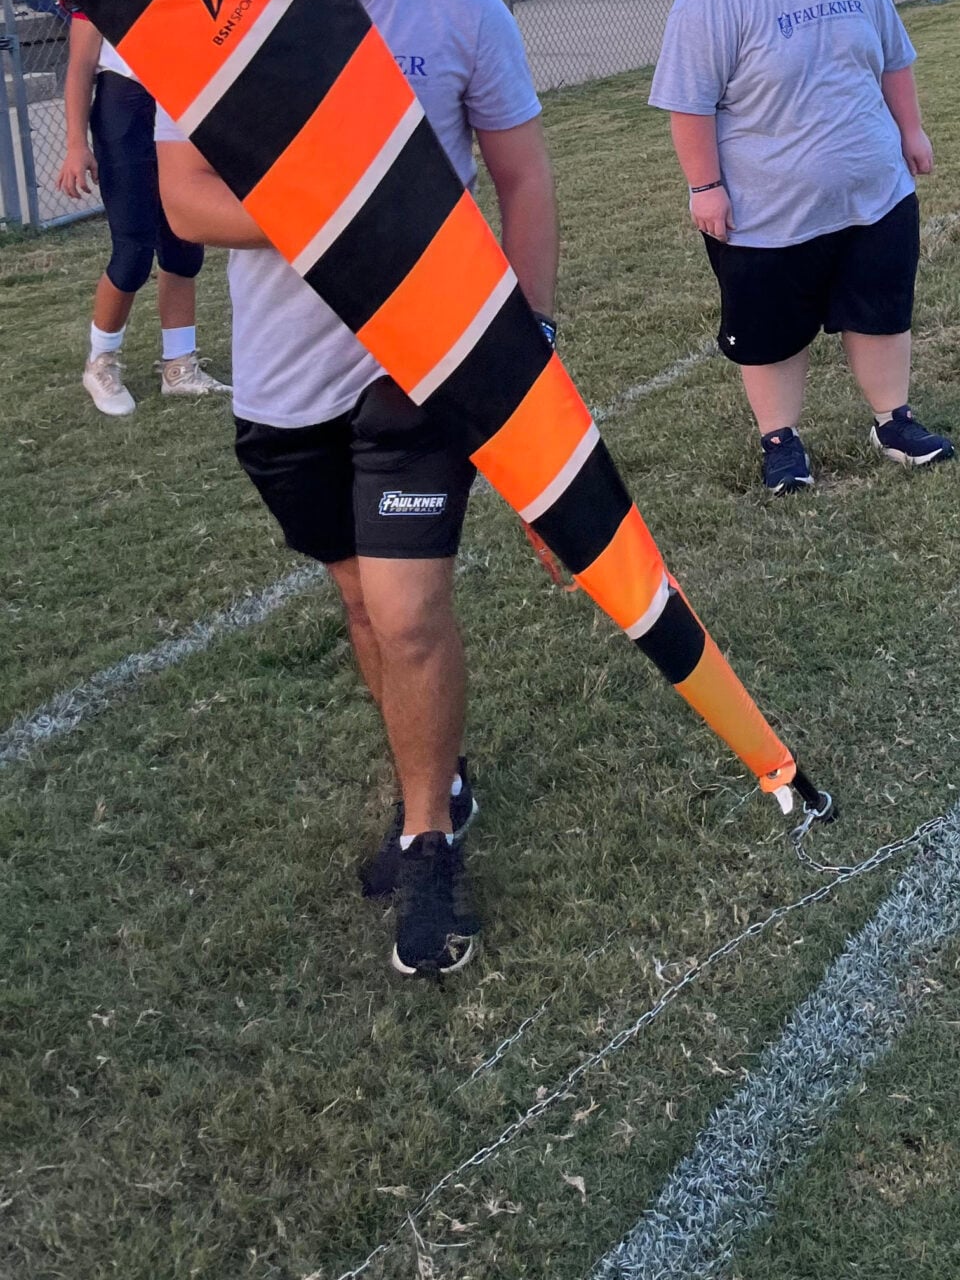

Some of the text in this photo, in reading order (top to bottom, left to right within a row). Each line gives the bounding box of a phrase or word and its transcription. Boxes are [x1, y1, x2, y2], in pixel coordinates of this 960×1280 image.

[793, 0, 864, 24] FAULKNER
[212, 19, 236, 46] BSN
[383, 494, 444, 511] FAULKNER
